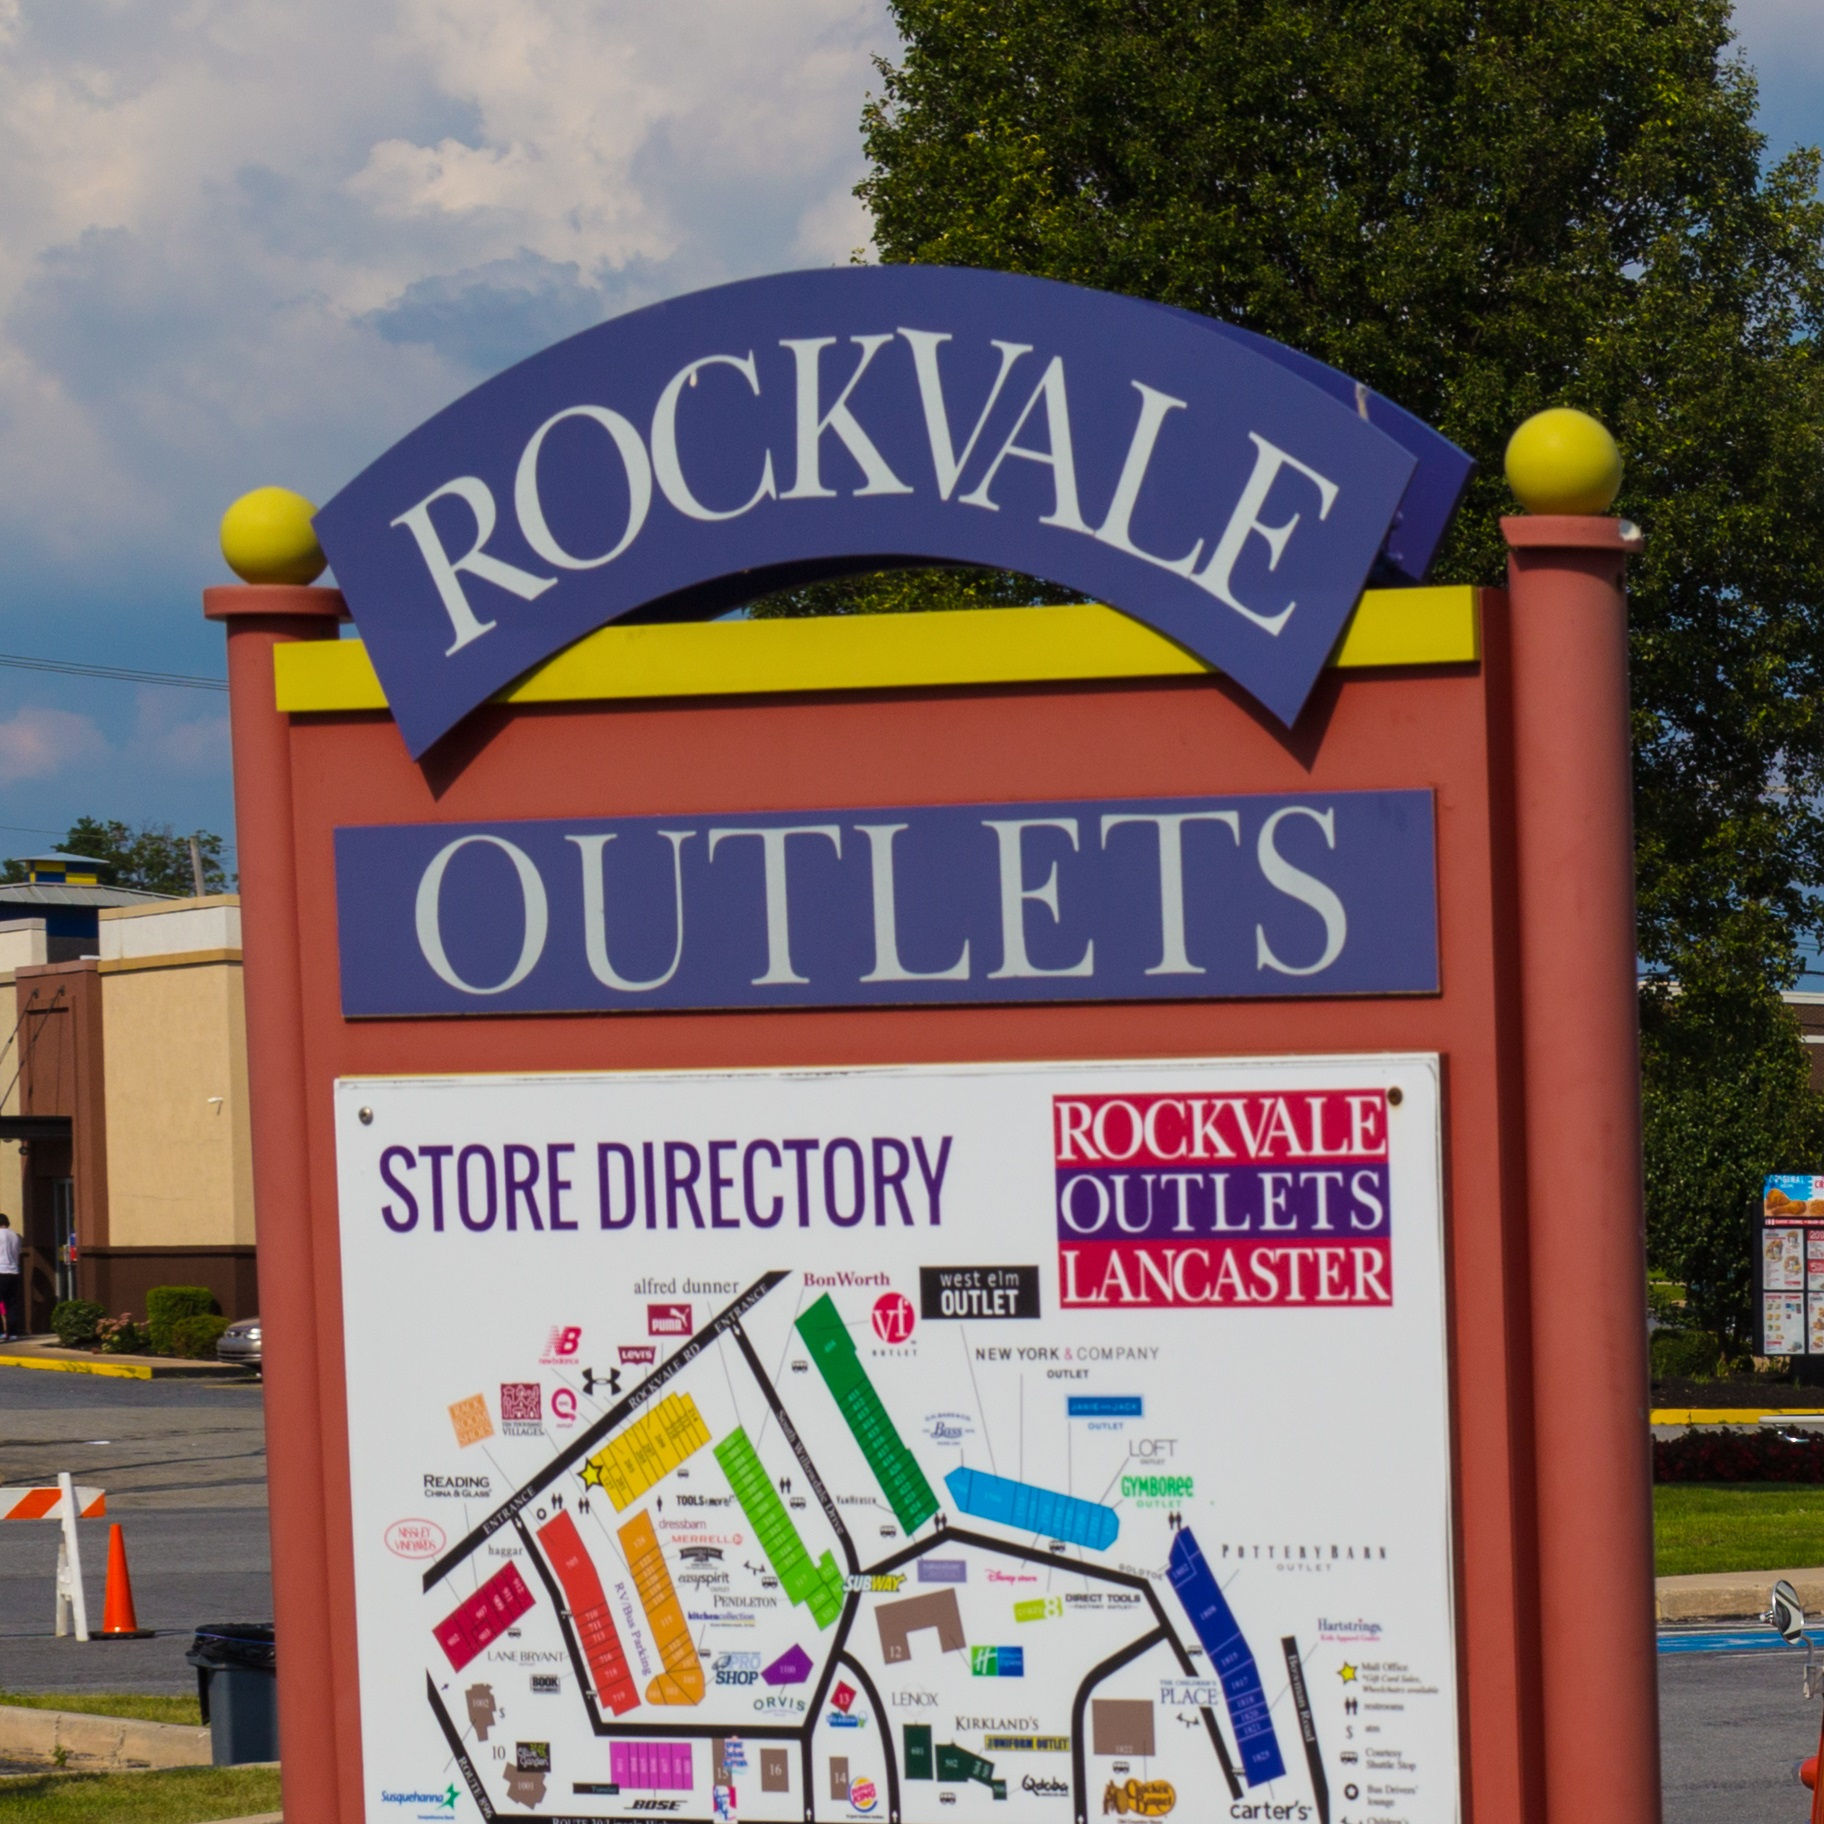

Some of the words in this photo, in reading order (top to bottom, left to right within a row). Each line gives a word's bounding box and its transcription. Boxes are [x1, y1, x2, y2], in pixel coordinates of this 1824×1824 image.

[391, 326, 1340, 657] ROCKVALE
[414, 806, 1349, 995] OUTLETS
[1056, 1096, 1387, 1160] ROCKVALE
[379, 1142, 579, 1233] STORE
[597, 1135, 954, 1230] DIRECTORY
[1060, 1170, 1384, 1234] OUTLETS
[803, 1271, 891, 1287] BonWorth
[940, 1271, 979, 1287] west
[988, 1270, 1019, 1287] elm
[1062, 1247, 1392, 1303] LANCASTER
[634, 1277, 676, 1295] alfred
[682, 1278, 739, 1295] dunner
[714, 1283, 768, 1333] ENTRANCE
[941, 1289, 1019, 1316] OUTLET
[652, 1318, 683, 1331] PUMA
[976, 1347, 1012, 1361] NEW
[1017, 1347, 1060, 1360] YORK
[1064, 1347, 1074, 1360] &
[1076, 1347, 1160, 1361] COMPANY
[629, 1358, 682, 1410] ROCKVALE
[684, 1343, 702, 1364] RD
[1047, 1370, 1089, 1379] OUTLET
[1088, 1422, 1124, 1431] OUTLET
[1128, 1439, 1178, 1457] LOFT
[423, 1474, 490, 1488] READING
[424, 1489, 451, 1498] CHINA
[461, 1489, 490, 1498] GLASS
[482, 1486, 536, 1536] ENTRANCE
[658, 1519, 708, 1530] dressbarn
[671, 1534, 731, 1544] MERRELL
[488, 1545, 524, 1558] haggar
[842, 1574, 905, 1593] SUBWAY
[713, 1594, 778, 1609] PENDLETON
[1066, 1594, 1103, 1604] DIRECT
[1107, 1594, 1141, 1603] TOOLS
[1318, 1618, 1383, 1634] Hartstrings
[487, 1651, 519, 1661] LANE
[519, 1651, 565, 1662] BRYANT
[631, 1630, 652, 1677] Parking
[715, 1671, 759, 1686] SHOP
[753, 1695, 806, 1712] ORVIS
[891, 1692, 939, 1706] LENOX
[1161, 1688, 1219, 1706] PLACE
[381, 1791, 445, 1804] Susquehanna
[630, 1799, 683, 1811] BOSE
